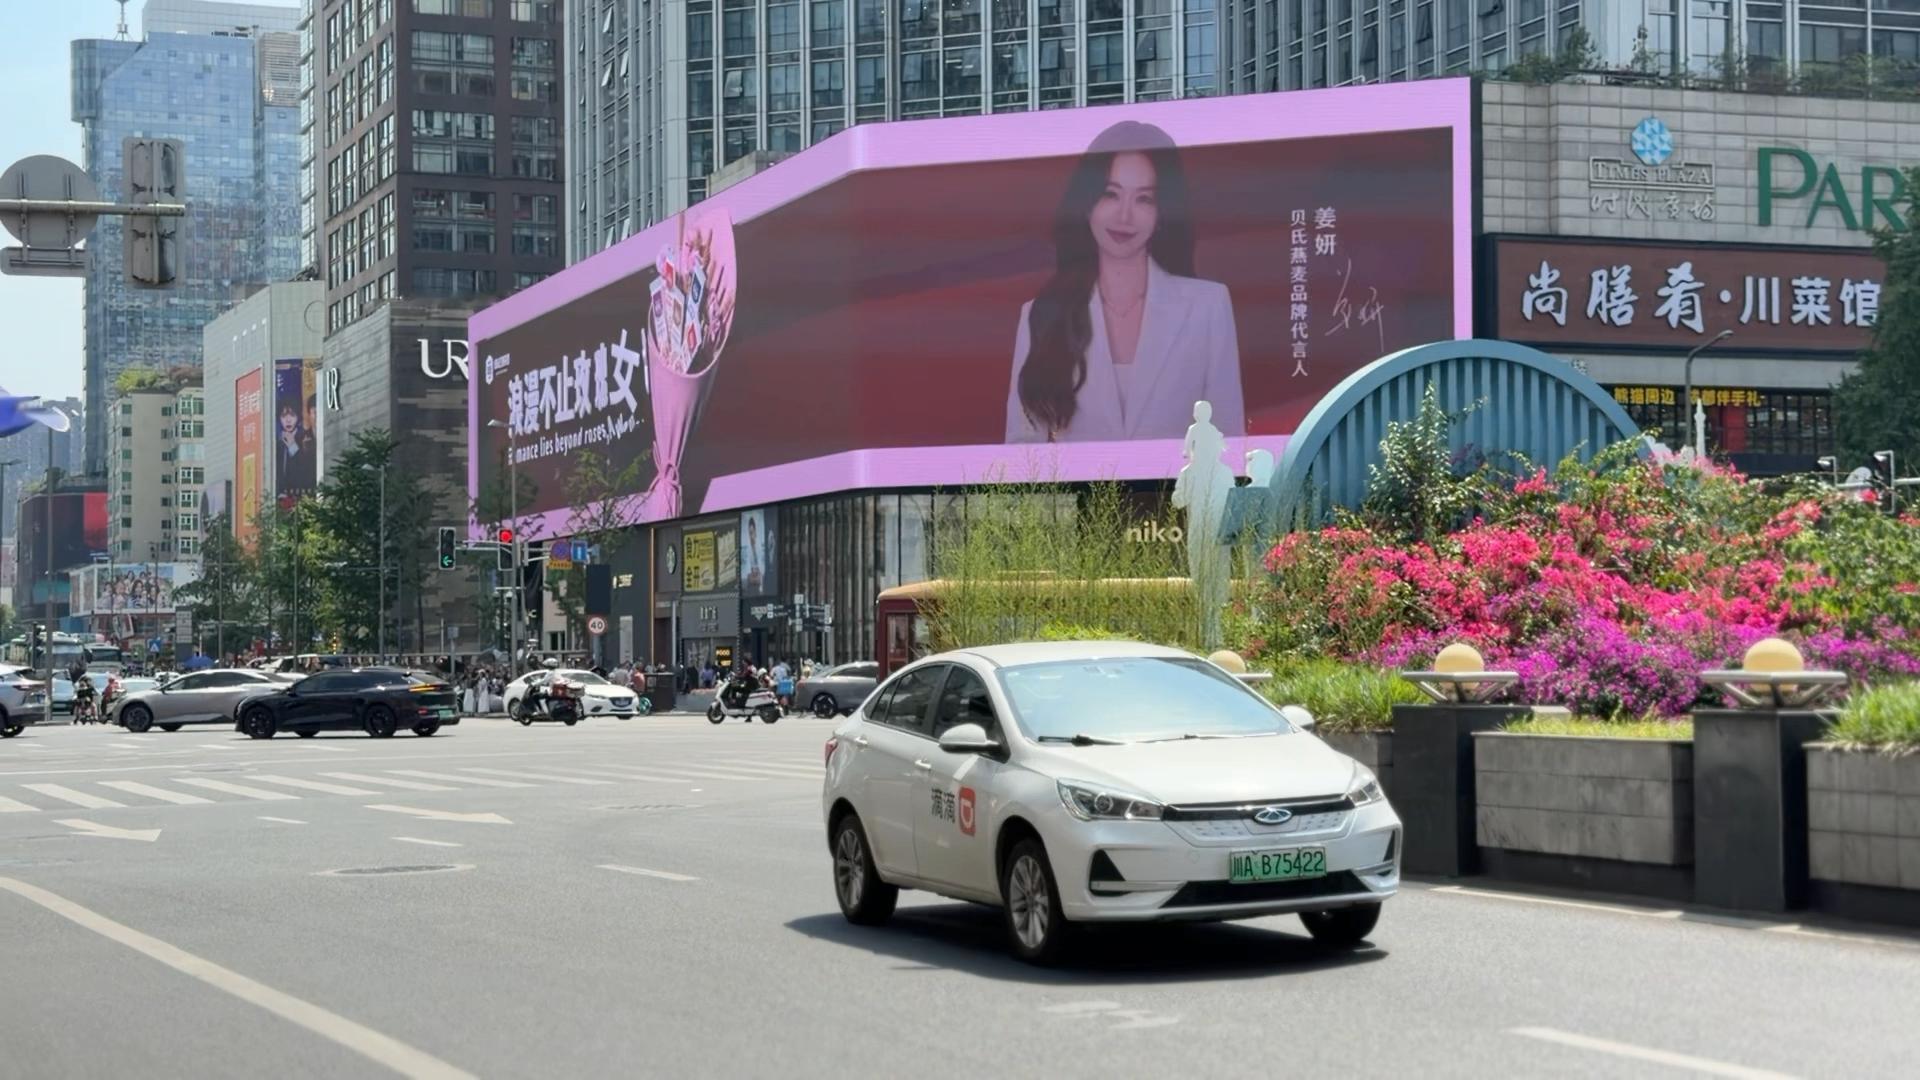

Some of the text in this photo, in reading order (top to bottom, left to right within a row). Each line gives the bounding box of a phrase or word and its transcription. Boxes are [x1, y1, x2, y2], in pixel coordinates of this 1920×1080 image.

[1594, 162, 1710, 184] TIMES PLAZA
[1314, 206, 1337, 256] 姜妍
[1290, 209, 1309, 377] 贝氏燕麦品牌代言人
[417, 338, 469, 380] UR
[326, 367, 340, 411] UR
[1614, 387, 1676, 405] 熊猫周边
[540, 437, 553, 457] lies
[555, 427, 583, 457] beyond
[590, 620, 604, 630] 40
[931, 788, 956, 824] 滴滴
